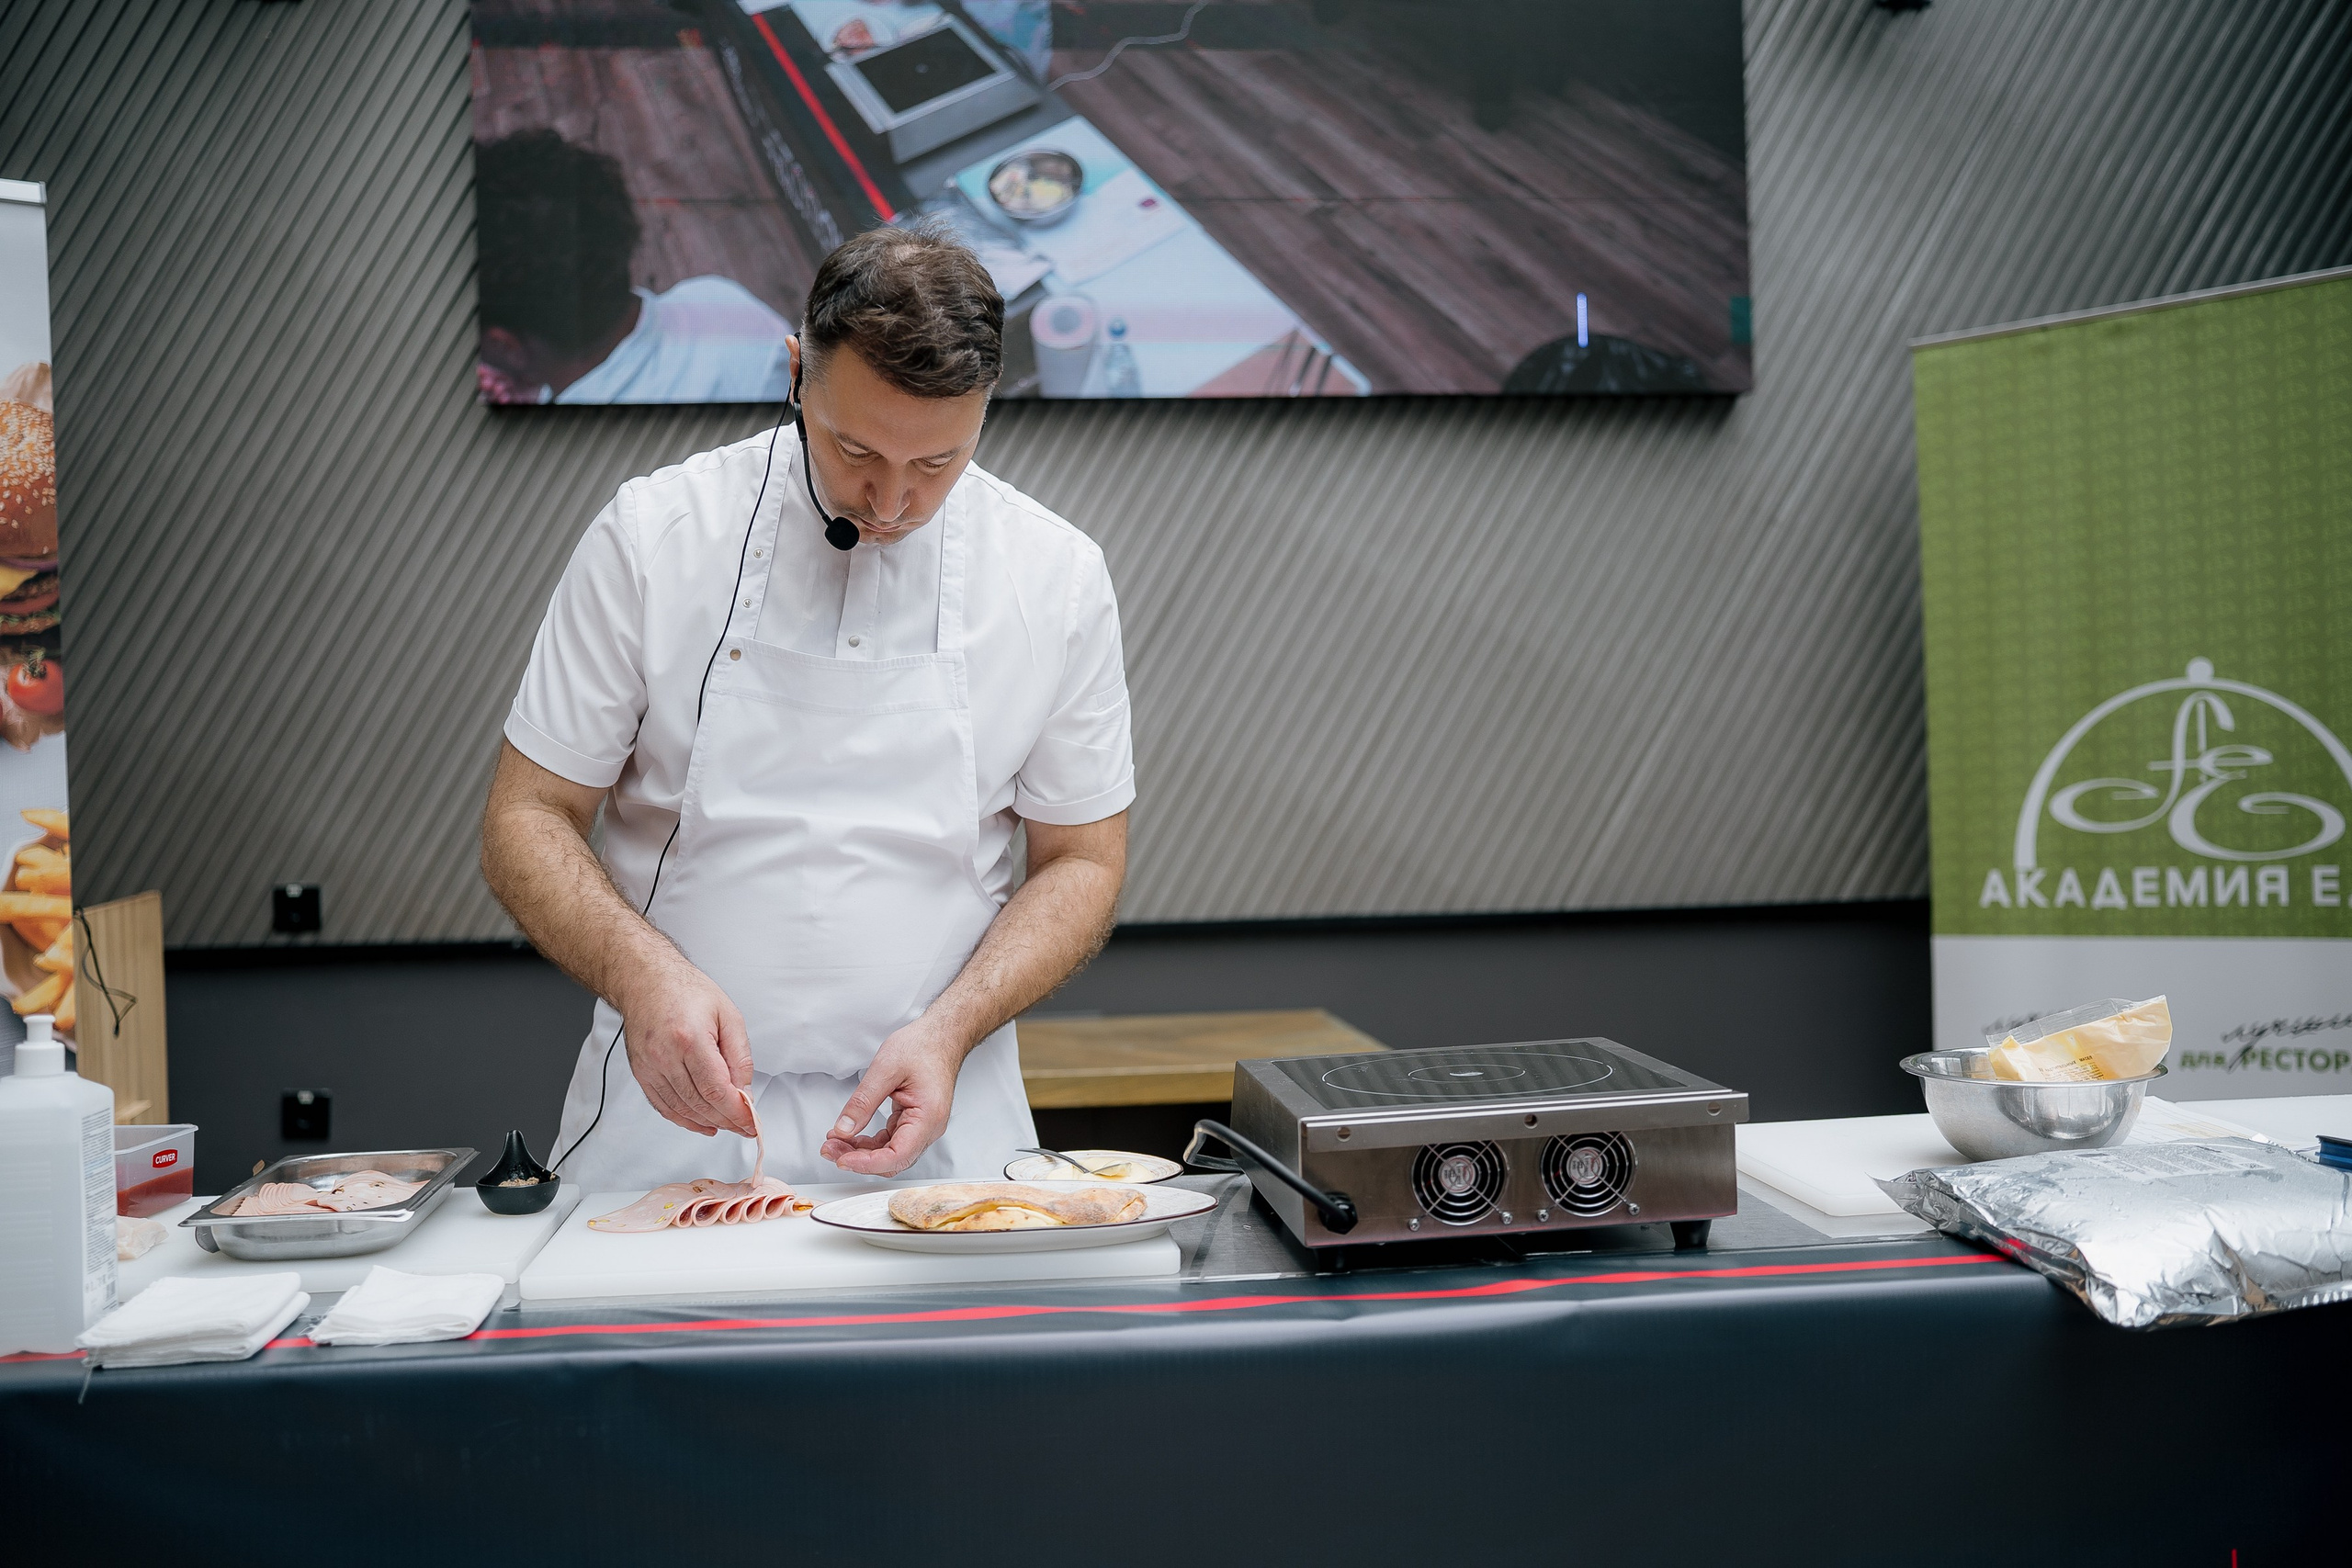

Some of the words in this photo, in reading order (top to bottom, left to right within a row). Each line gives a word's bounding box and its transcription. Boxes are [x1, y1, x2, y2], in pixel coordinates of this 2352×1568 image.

[1979, 865, 2290, 909] АКАДЕМИЯ
[2312, 864, 2352, 908] Е
[2242, 1046, 2352, 1073] РЕСТОР
[155, 1153, 175, 1164] CURVER
